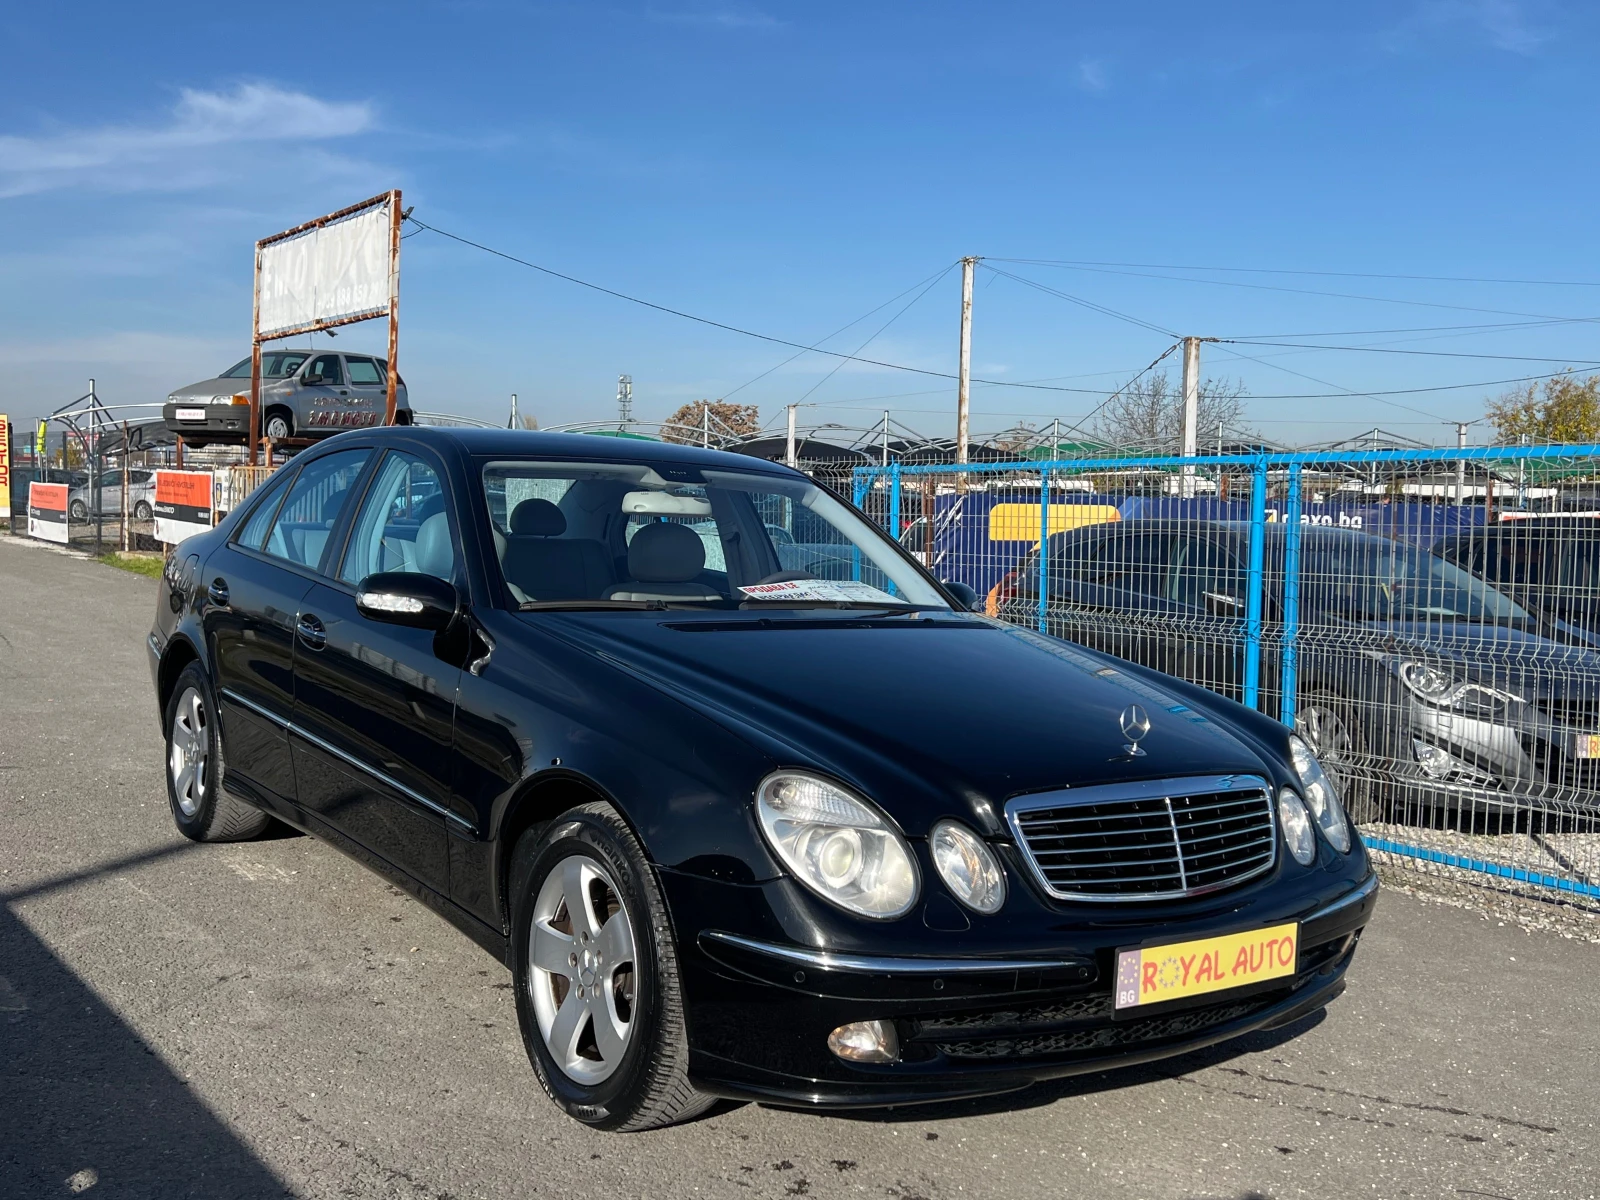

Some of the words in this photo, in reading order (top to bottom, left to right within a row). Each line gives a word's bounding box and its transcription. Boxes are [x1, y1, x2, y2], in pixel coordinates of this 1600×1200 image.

[1142, 950, 1225, 994] ROYAL
[1232, 935, 1294, 976] AUTO
[1120, 989, 1135, 1005] BG
